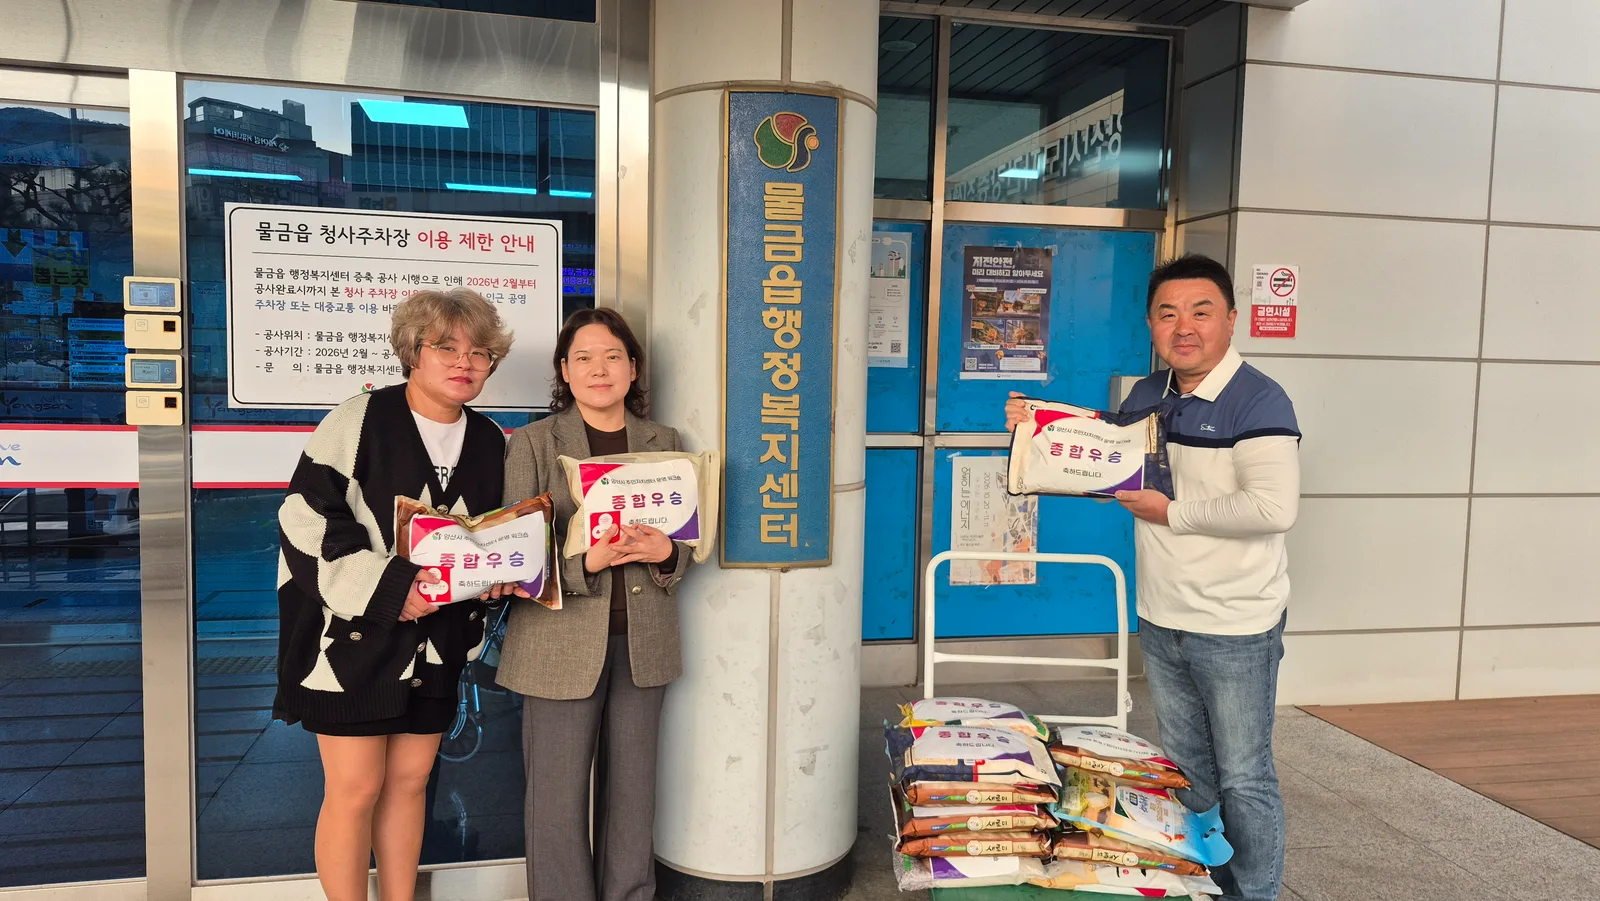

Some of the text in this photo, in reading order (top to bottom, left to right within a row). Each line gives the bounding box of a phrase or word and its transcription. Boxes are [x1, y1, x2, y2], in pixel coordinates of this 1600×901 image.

[256, 221, 534, 253] 물금읍 청사주차장 이용 제한 안내
[254, 267, 537, 290] 물금읍 행정복지센터 증축 공사 시행으로 인해 2026년 2월부터
[972, 268, 1044, 278] 미리 대비하고 알아두세요
[254, 283, 326, 296] 공사완료시까지
[330, 285, 341, 297] 본
[344, 286, 364, 298] 청사
[367, 287, 398, 300] 주차장
[486, 292, 505, 304] 인근
[508, 293, 527, 305] 공영
[255, 299, 286, 312] 주차장
[290, 301, 311, 312] 또는
[314, 301, 356, 314] 대중교통
[359, 303, 379, 314] 이용
[1257, 306, 1291, 317] 금연시설
[263, 329, 303, 341] 공사위치
[314, 331, 345, 343] 물금읍
[264, 346, 304, 358] 공사기간
[315, 347, 349, 359] 2026년
[352, 348, 368, 359] 2월
[314, 363, 344, 374] 물금읍
[443, 533, 464, 541] 양산시
[985, 794, 1008, 802] 새로미
[986, 819, 1008, 827] 새로미
[986, 844, 1008, 852] 새로미
